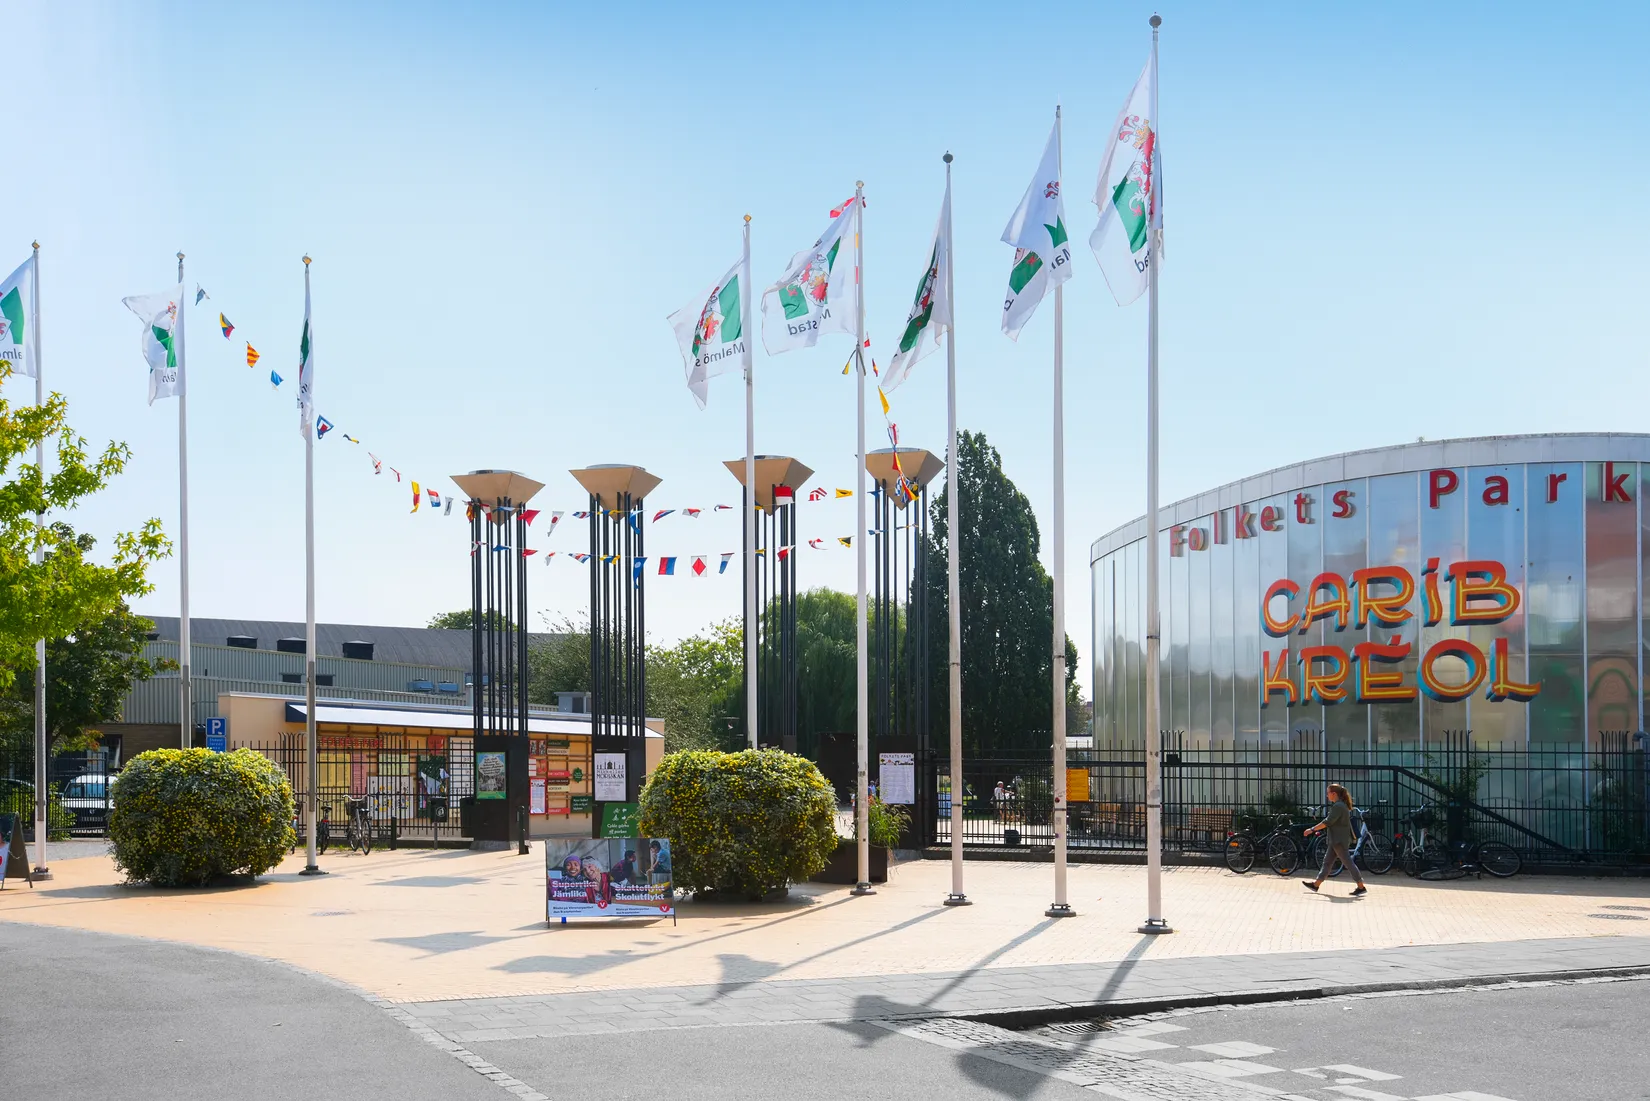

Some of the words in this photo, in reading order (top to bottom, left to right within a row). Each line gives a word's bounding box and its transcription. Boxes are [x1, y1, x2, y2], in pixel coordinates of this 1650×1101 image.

[1169, 489, 1357, 558] Folkets
[1429, 461, 1633, 509] Park
[211, 719, 222, 735] P
[552, 880, 598, 889] Superrika
[614, 884, 665, 893] Skatteflykt
[552, 889, 588, 898] Jämlika
[615, 893, 665, 902] Skolutflykt
